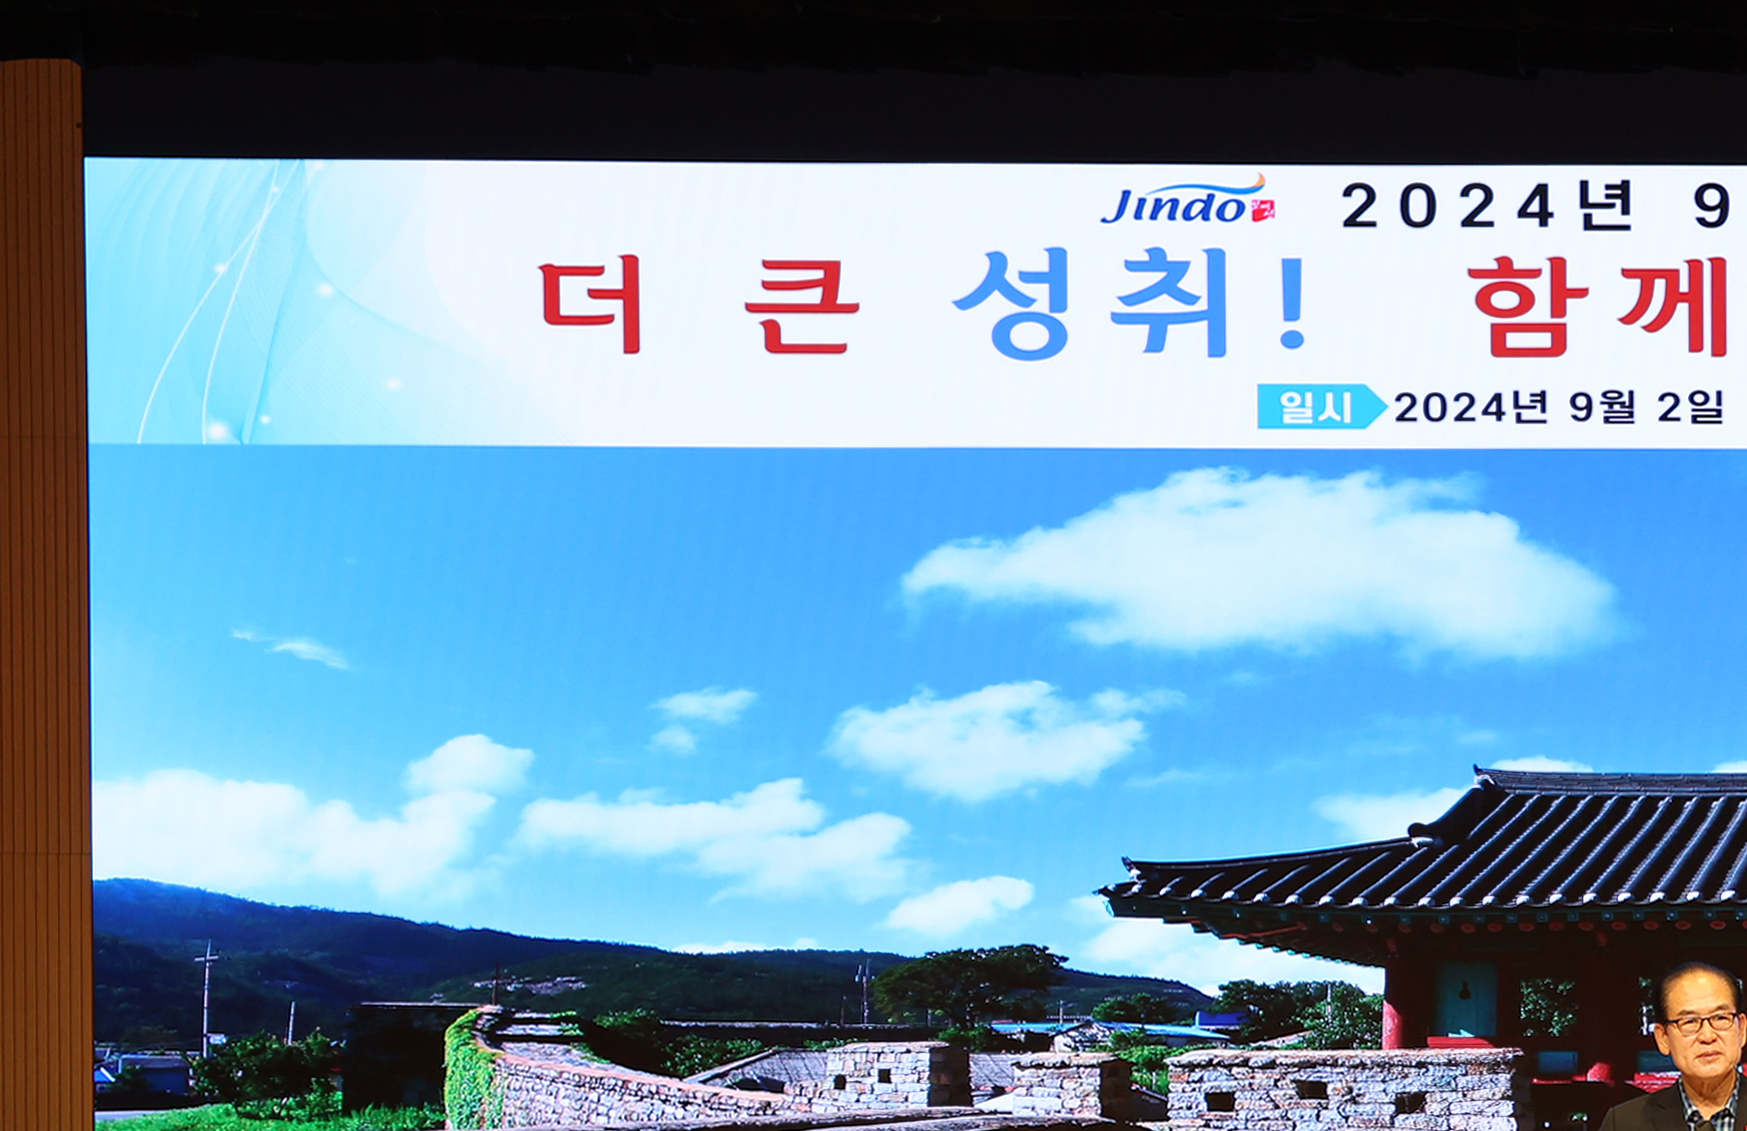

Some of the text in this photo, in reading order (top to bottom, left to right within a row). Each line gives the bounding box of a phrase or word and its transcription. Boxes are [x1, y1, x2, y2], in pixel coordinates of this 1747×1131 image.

[1100, 189, 1247, 224] Jindo
[1341, 179, 1632, 232] 2024년
[537, 253, 641, 355] 더
[744, 259, 860, 355] 큰
[952, 246, 1305, 362] 성취!
[1467, 255, 1728, 358] 함께
[1280, 388, 1723, 425] 일시 2024년 9월 2일
